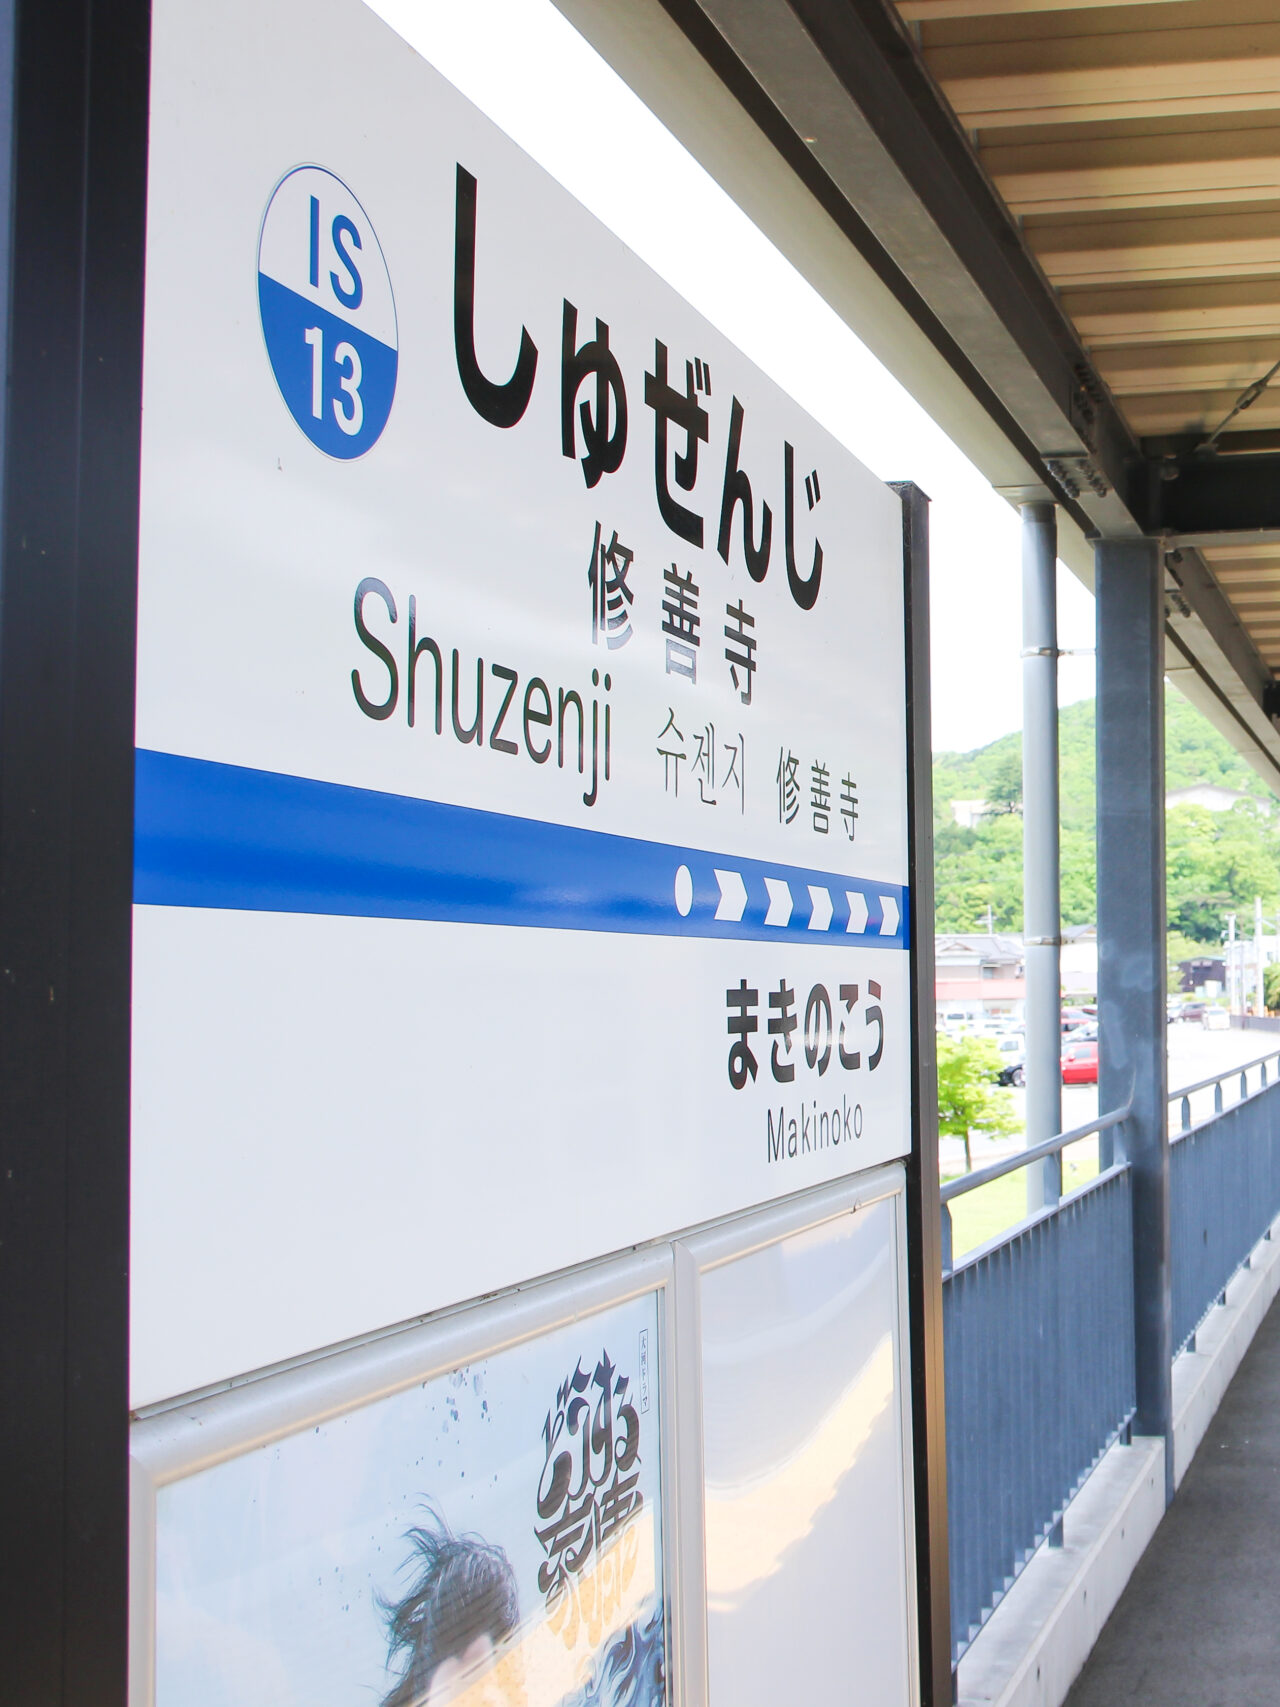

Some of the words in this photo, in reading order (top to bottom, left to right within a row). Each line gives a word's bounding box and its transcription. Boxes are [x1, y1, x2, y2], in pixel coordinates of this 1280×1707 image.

[309, 194, 364, 310] IS
[304, 326, 364, 436] 13
[453, 162, 824, 611] しゅぜんじ
[587, 520, 757, 706] 修善寺
[351, 576, 613, 808] Shuzenji
[656, 706, 746, 816] 슈젠지
[776, 746, 859, 842] 修善寺
[725, 978, 885, 1091] まきのこう
[767, 1093, 864, 1164] Makinoko
